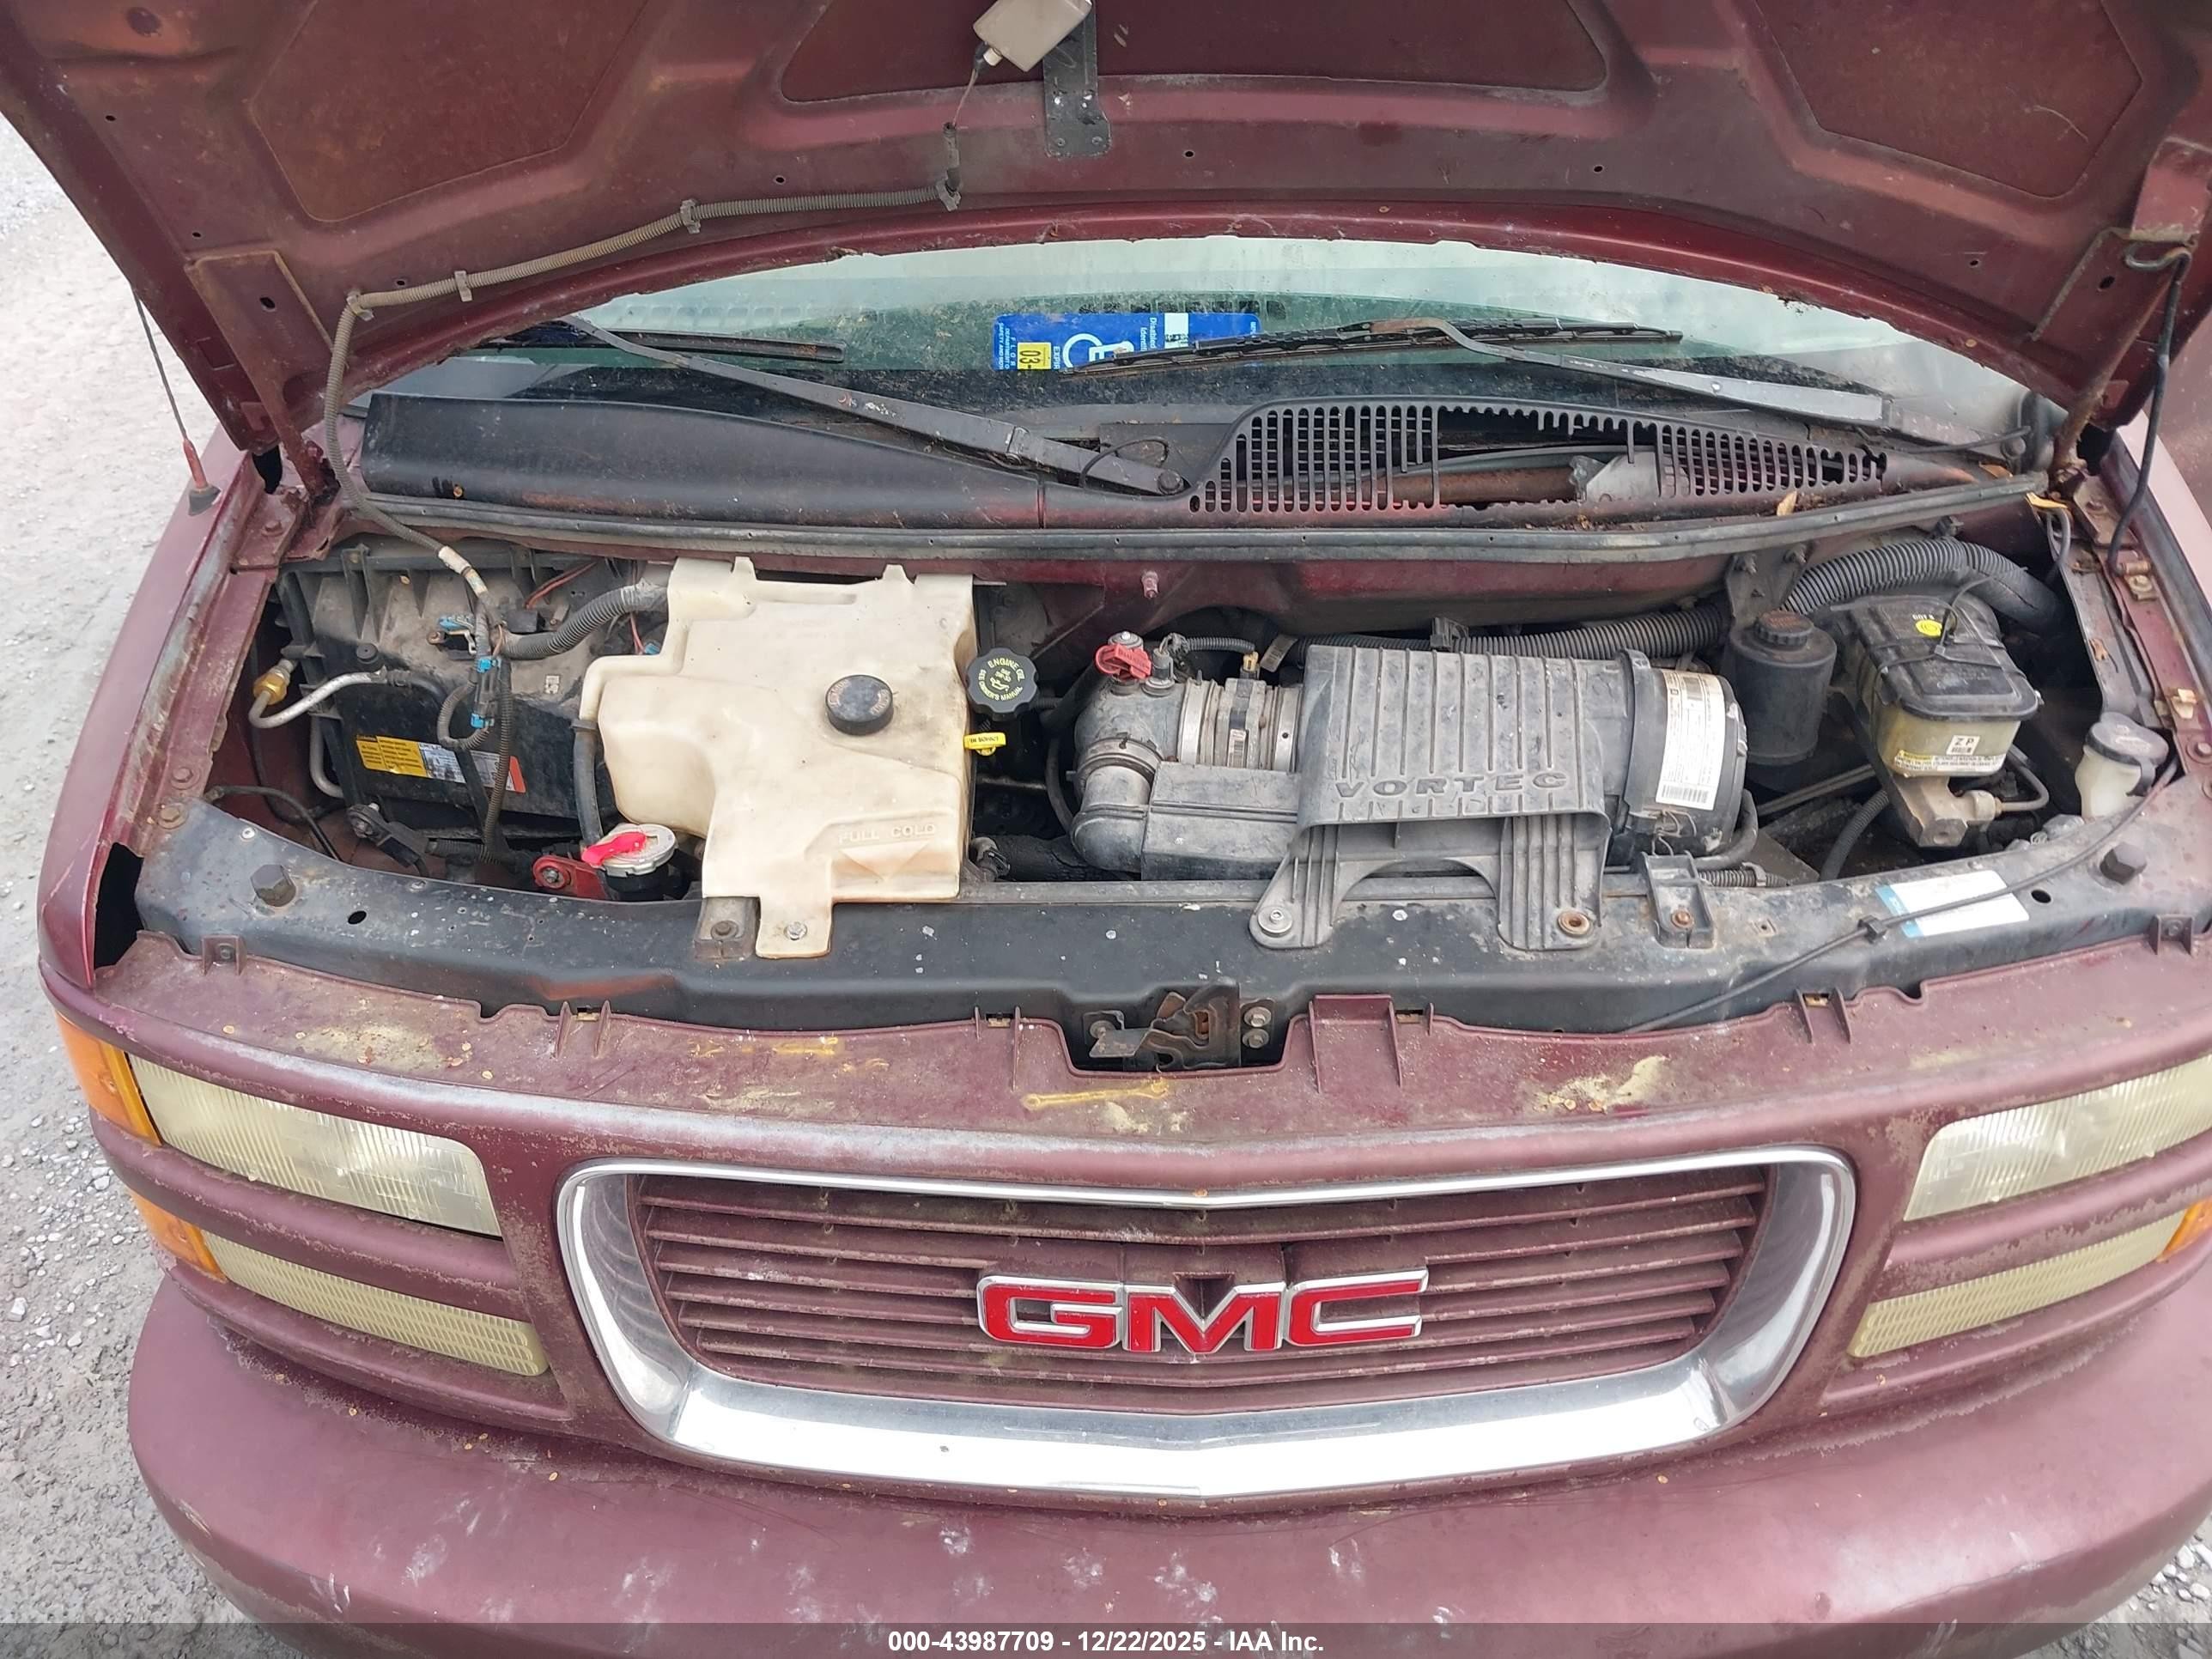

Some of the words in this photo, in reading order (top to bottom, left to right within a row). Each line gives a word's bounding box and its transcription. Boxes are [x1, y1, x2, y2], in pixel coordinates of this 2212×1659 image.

[988, 657, 1020, 672] ENGINE
[1015, 668, 1025, 682] OIL
[978, 669, 987, 680] SEE
[1000, 686, 1024, 701] MANUAL
[1335, 772, 1567, 798] VORTEC
[839, 830, 880, 844] FULL
[890, 823, 936, 838] COLD
[976, 1269, 1429, 1354] GMC
